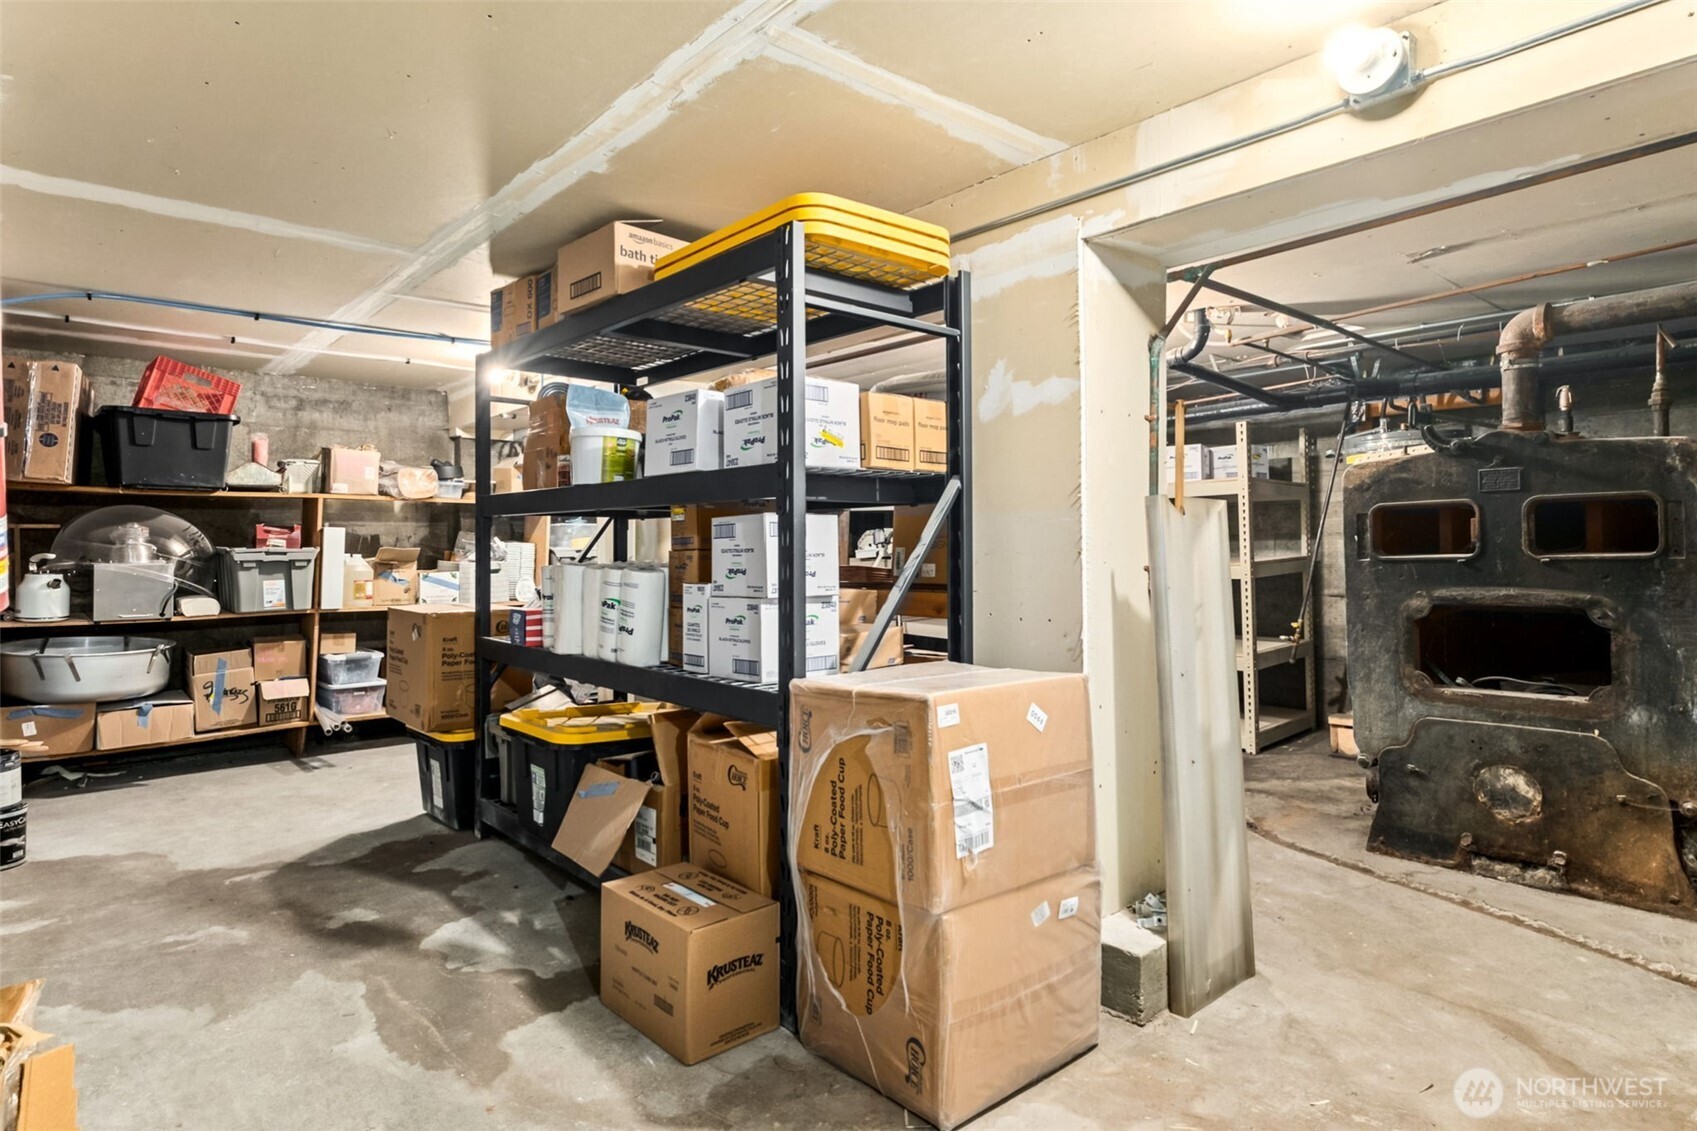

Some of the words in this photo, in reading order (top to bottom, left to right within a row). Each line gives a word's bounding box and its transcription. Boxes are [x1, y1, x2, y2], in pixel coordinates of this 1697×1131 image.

[620, 244, 647, 263] bath
[662, 413, 680, 424] ProPak
[743, 436, 765, 447] ProPak
[727, 568, 747, 576] ProPak
[725, 617, 743, 625] ProPak
[441, 651, 475, 660] Poly-Coa
[441, 660, 462, 668] Paper
[838, 757, 846, 784] Cup
[693, 793, 720, 814] Poly-Coated
[693, 803, 706, 816] Paper
[706, 810, 718, 823] Food
[719, 816, 729, 830] Cup
[838, 787, 846, 819] Food
[830, 780, 839, 858] Poly-Coated
[838, 822, 847, 860] Paper
[625, 920, 660, 954] KRUSTEAZ
[866, 911, 875, 949] Paper
[866, 953, 875, 985] Food
[875, 915, 885, 996] Poly-Coated
[706, 953, 765, 991] KRUSTEAZ
[866, 988, 875, 1016] Cup
